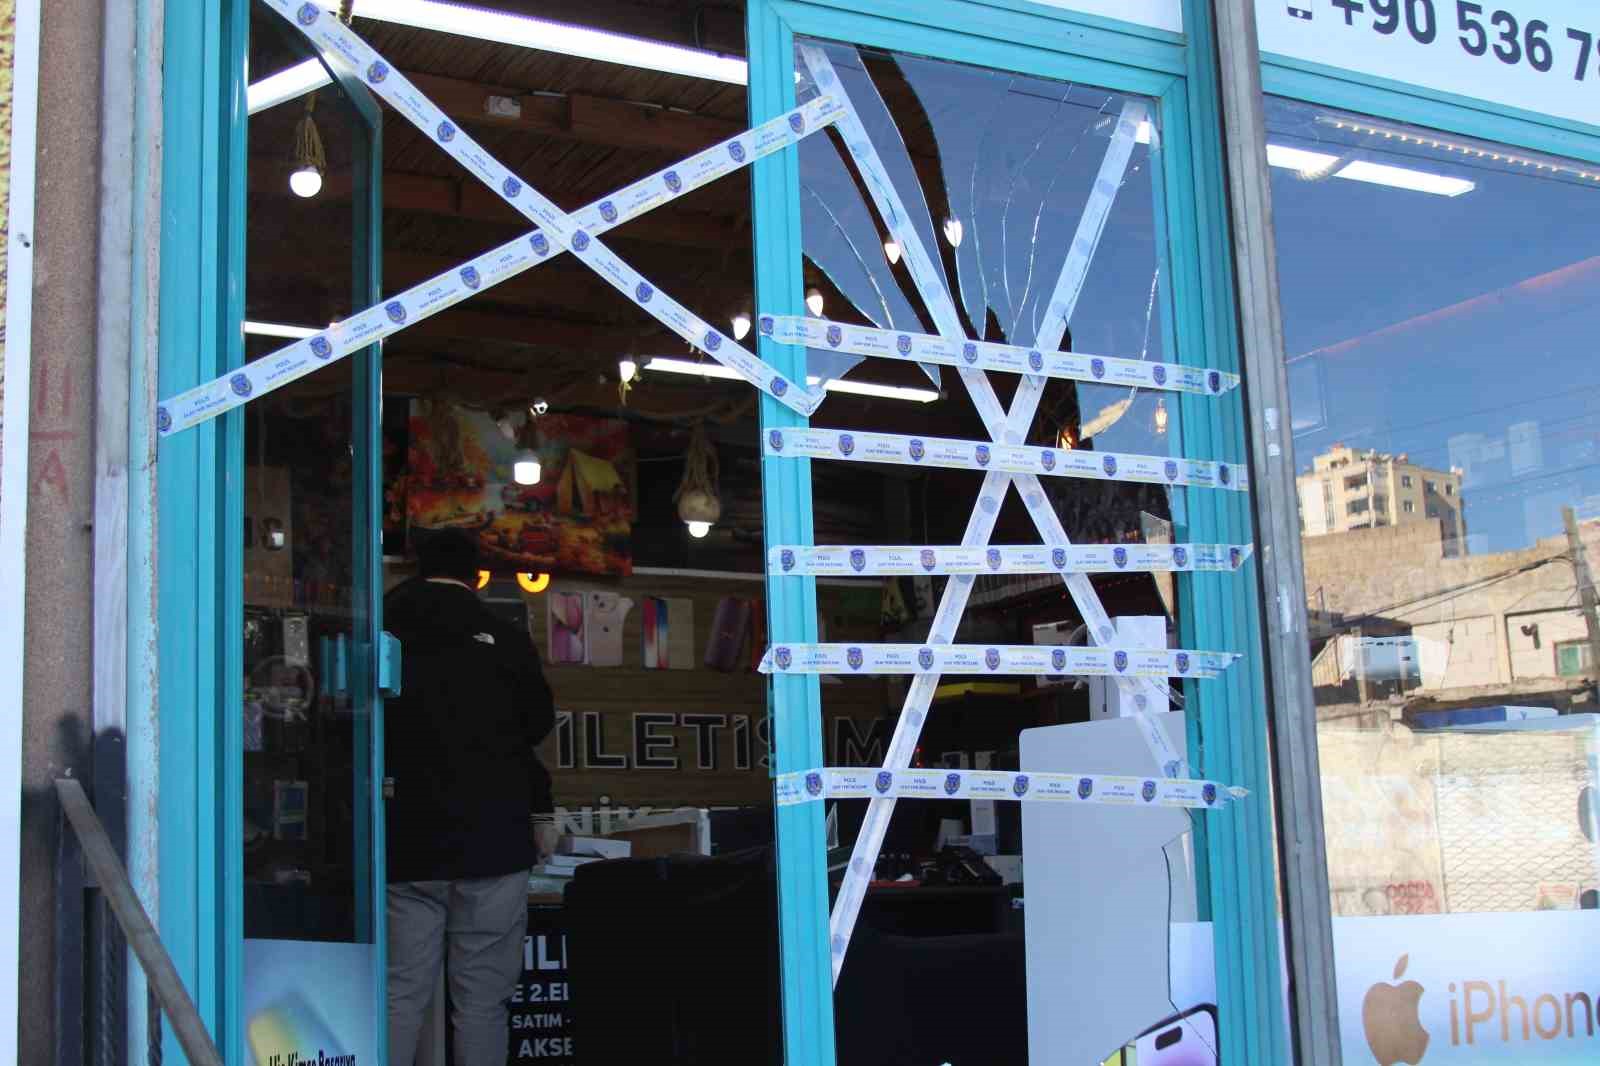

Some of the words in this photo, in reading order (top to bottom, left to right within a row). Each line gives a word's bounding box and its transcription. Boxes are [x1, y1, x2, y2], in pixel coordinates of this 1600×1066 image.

[1331, 0, 1436, 45] +90
[1457, 0, 1553, 73] 536
[1566, 27, 1600, 82] 7
[511, 1013, 562, 1029] SATIM
[1448, 979, 1600, 1047] iPhon
